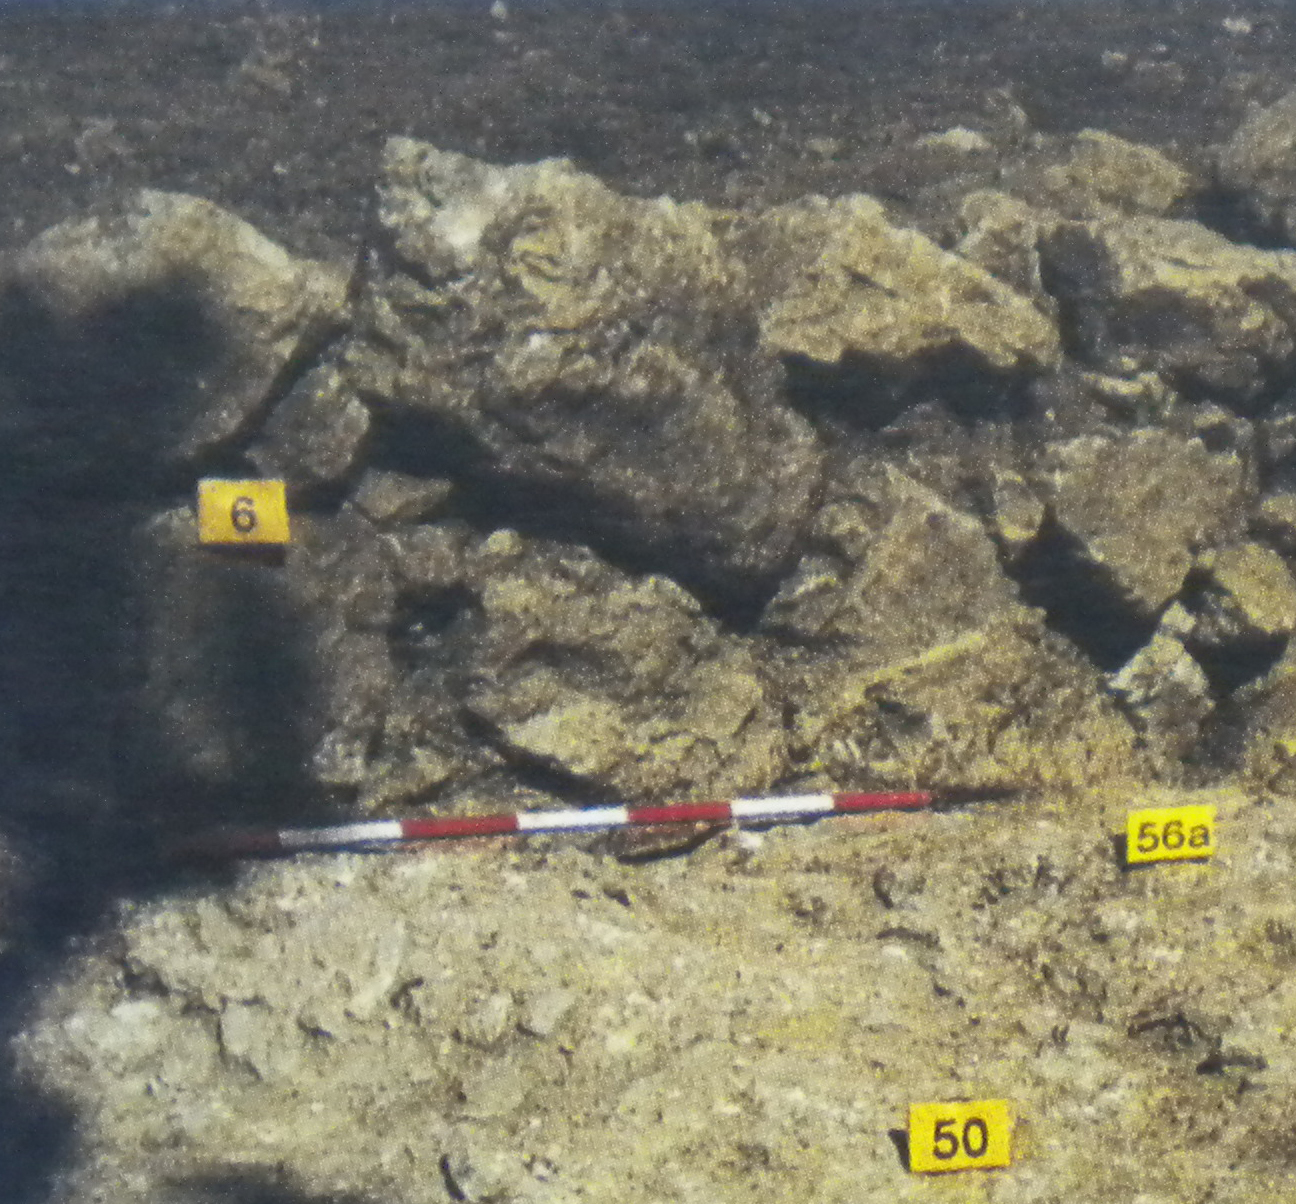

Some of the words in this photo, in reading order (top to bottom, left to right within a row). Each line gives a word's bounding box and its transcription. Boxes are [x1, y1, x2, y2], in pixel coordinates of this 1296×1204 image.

[230, 496, 257, 533] 6
[1137, 820, 1210, 852] 56a
[933, 1117, 989, 1160] 50
